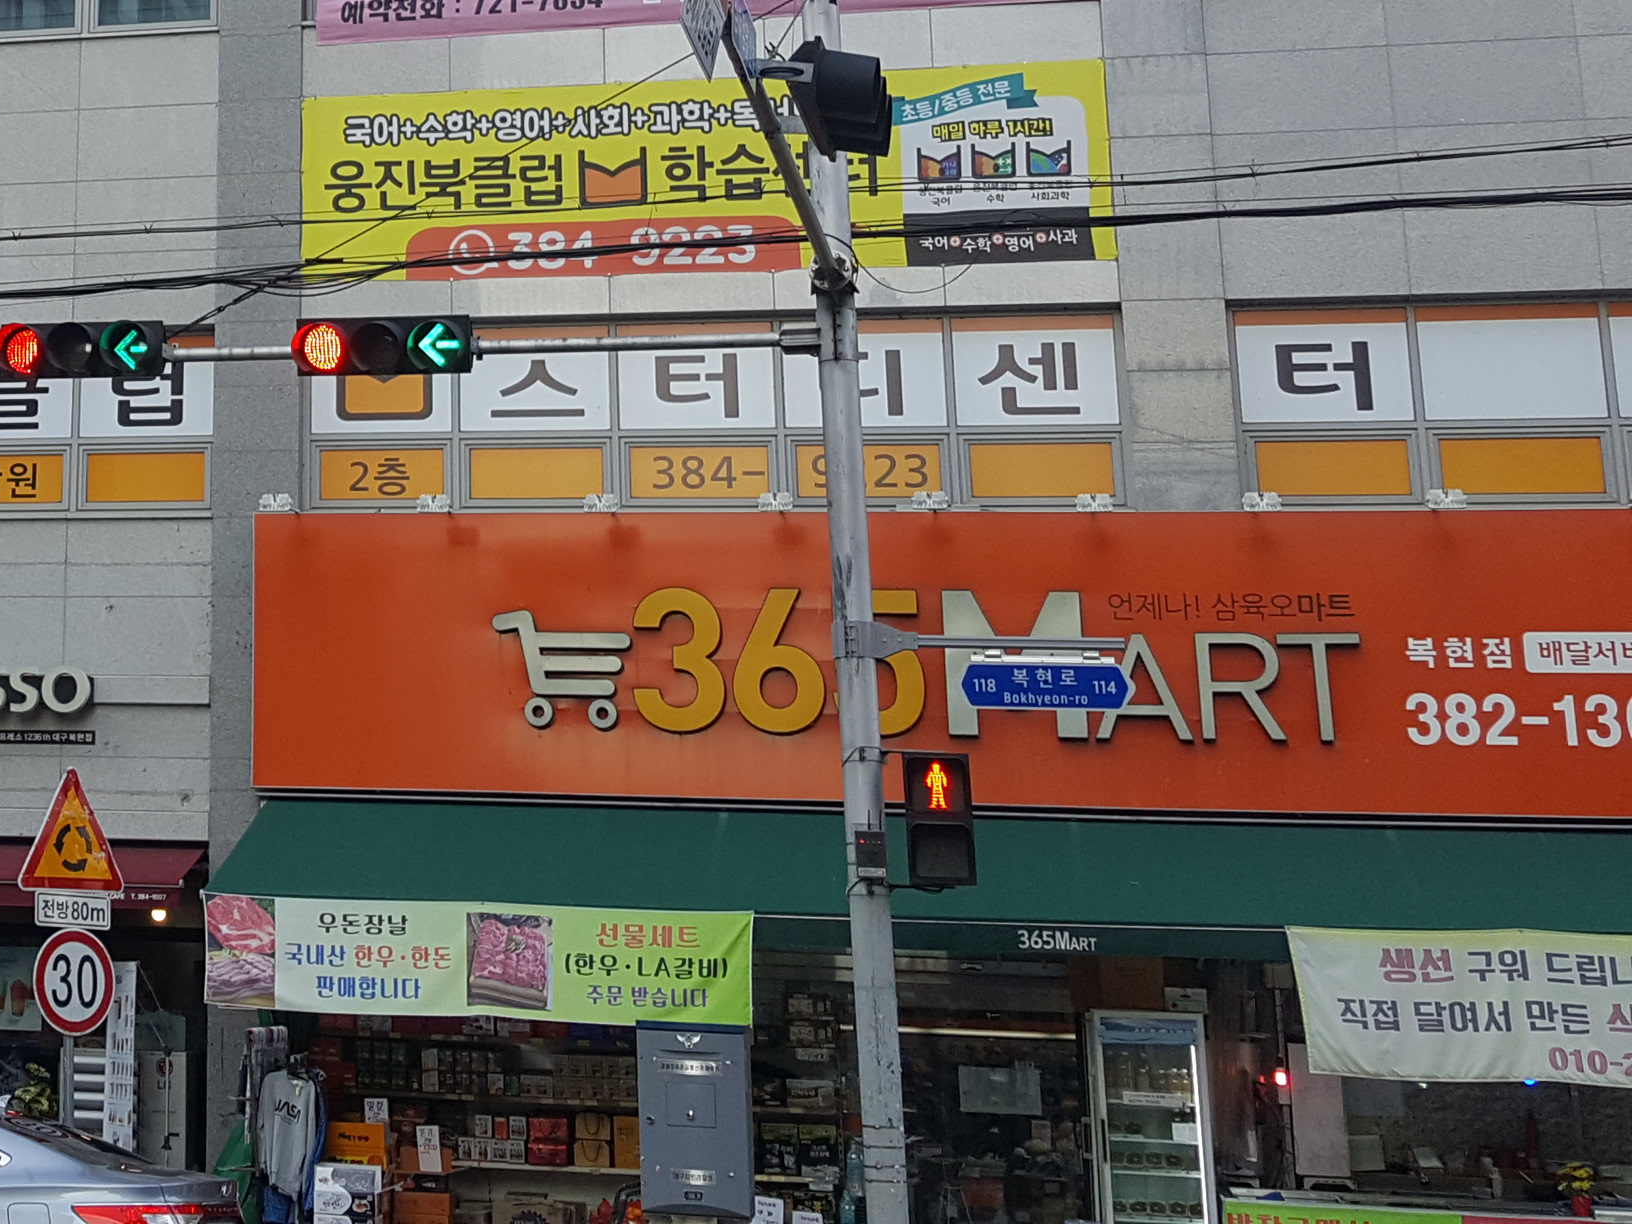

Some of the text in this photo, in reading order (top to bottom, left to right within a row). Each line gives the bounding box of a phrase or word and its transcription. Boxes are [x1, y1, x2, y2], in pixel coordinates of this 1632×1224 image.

[977, 79, 1012, 100] 전문
[932, 119, 1053, 141] 매일 하루 1시간!
[323, 154, 564, 214] 웅진북클럽
[1031, 191, 1070, 202] 사회과학
[931, 197, 951, 207] 국어
[986, 193, 1005, 204] 수학
[349, 457, 411, 497] 2층
[1108, 592, 1356, 624] 언제나! 삼육오마트
[1405, 637, 1513, 669] 복현점
[972, 667, 1117, 695] 118 복현로 114
[1003, 691, 1088, 706] Bokhyeon-ro
[1405, 692, 1632, 748] 382-13
[317, 912, 409, 936] 우돈장날
[595, 922, 701, 950] 선물세트
[284, 942, 346, 968] 국내산
[1378, 947, 1530, 983] 생선 구워
[51, 953, 98, 1010] 30
[315, 975, 421, 1000] 판매합니다
[585, 984, 710, 1009] 주문 받습니다
[1336, 997, 1401, 1033] 직접
[1412, 1000, 1513, 1033] 달여서
[1525, 1000, 1591, 1035] 만든
